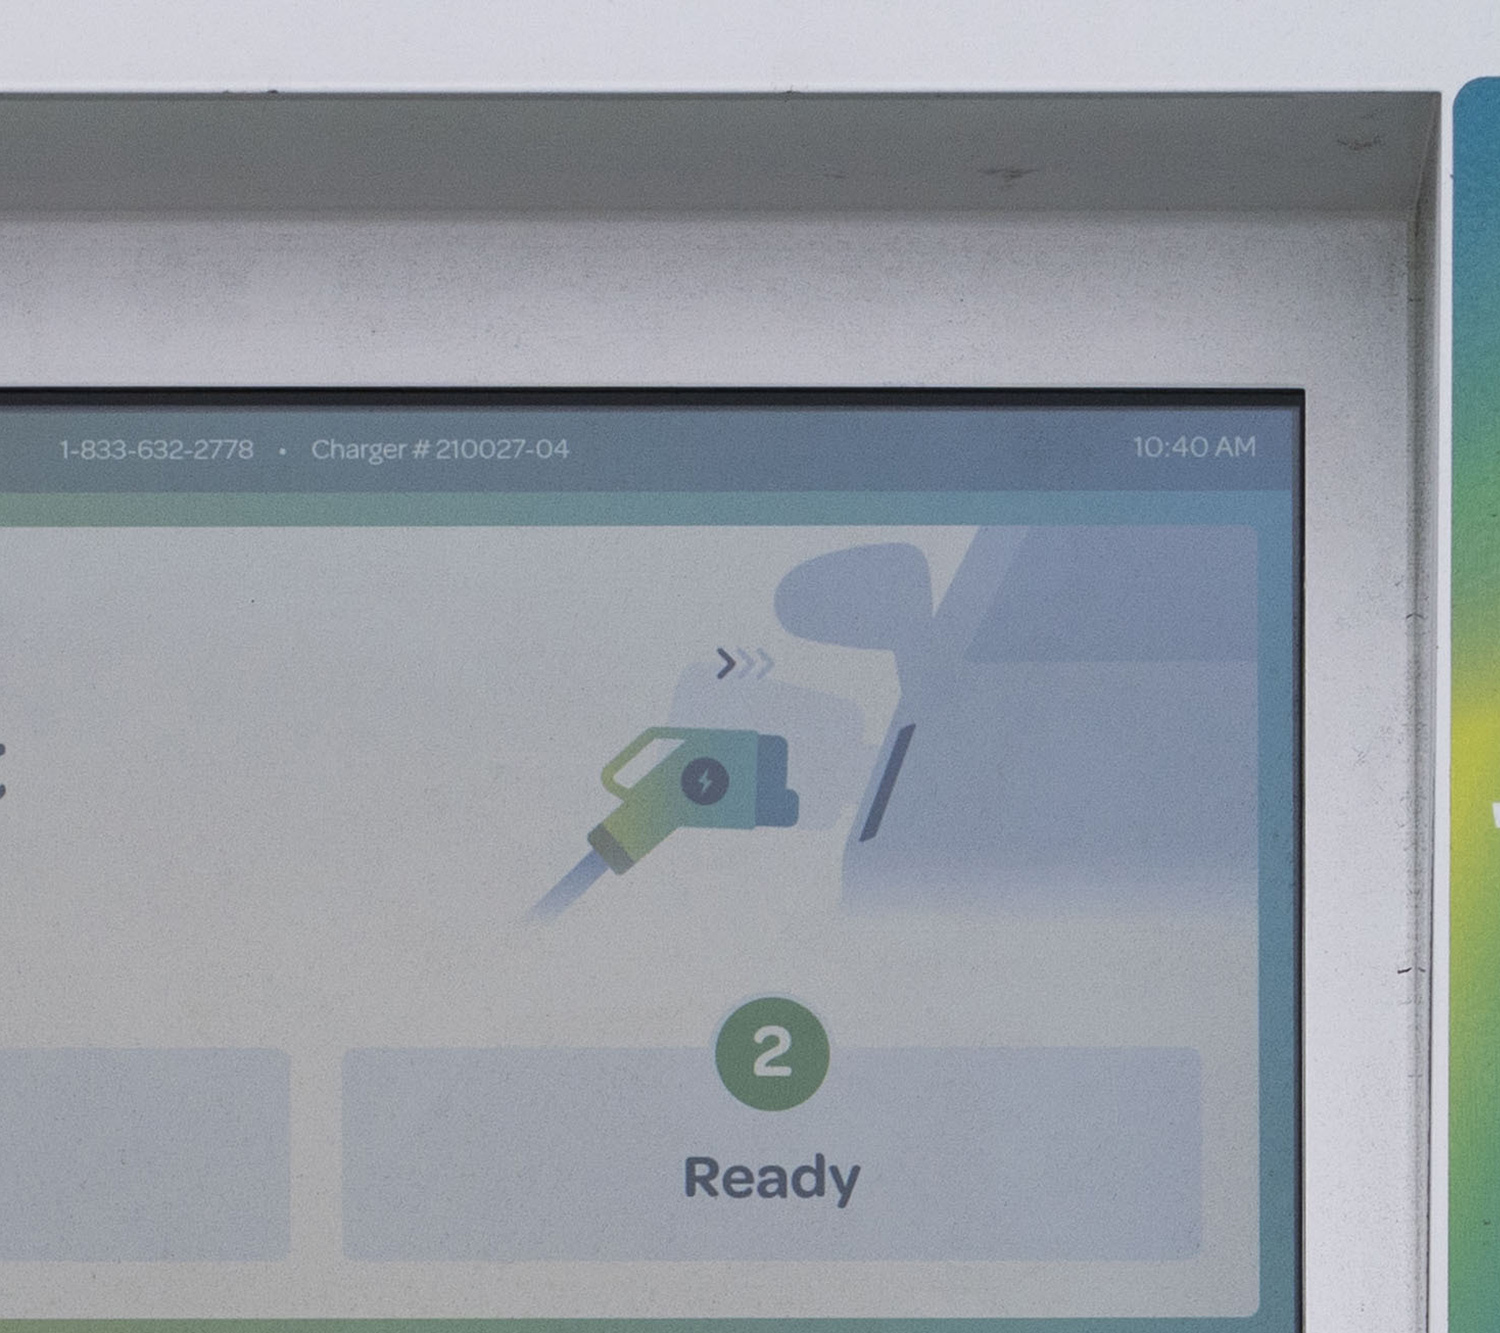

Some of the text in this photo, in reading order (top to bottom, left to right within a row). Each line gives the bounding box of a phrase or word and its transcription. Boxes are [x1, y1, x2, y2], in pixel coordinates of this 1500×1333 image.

[60, 438, 254, 461] 1-833-632-2778
[311, 438, 407, 466] Charger
[436, 438, 570, 460] 210027-04
[1133, 435, 1256, 458] 10:40 AM
[753, 1025, 792, 1077] 2
[685, 1152, 861, 1209] Ready
